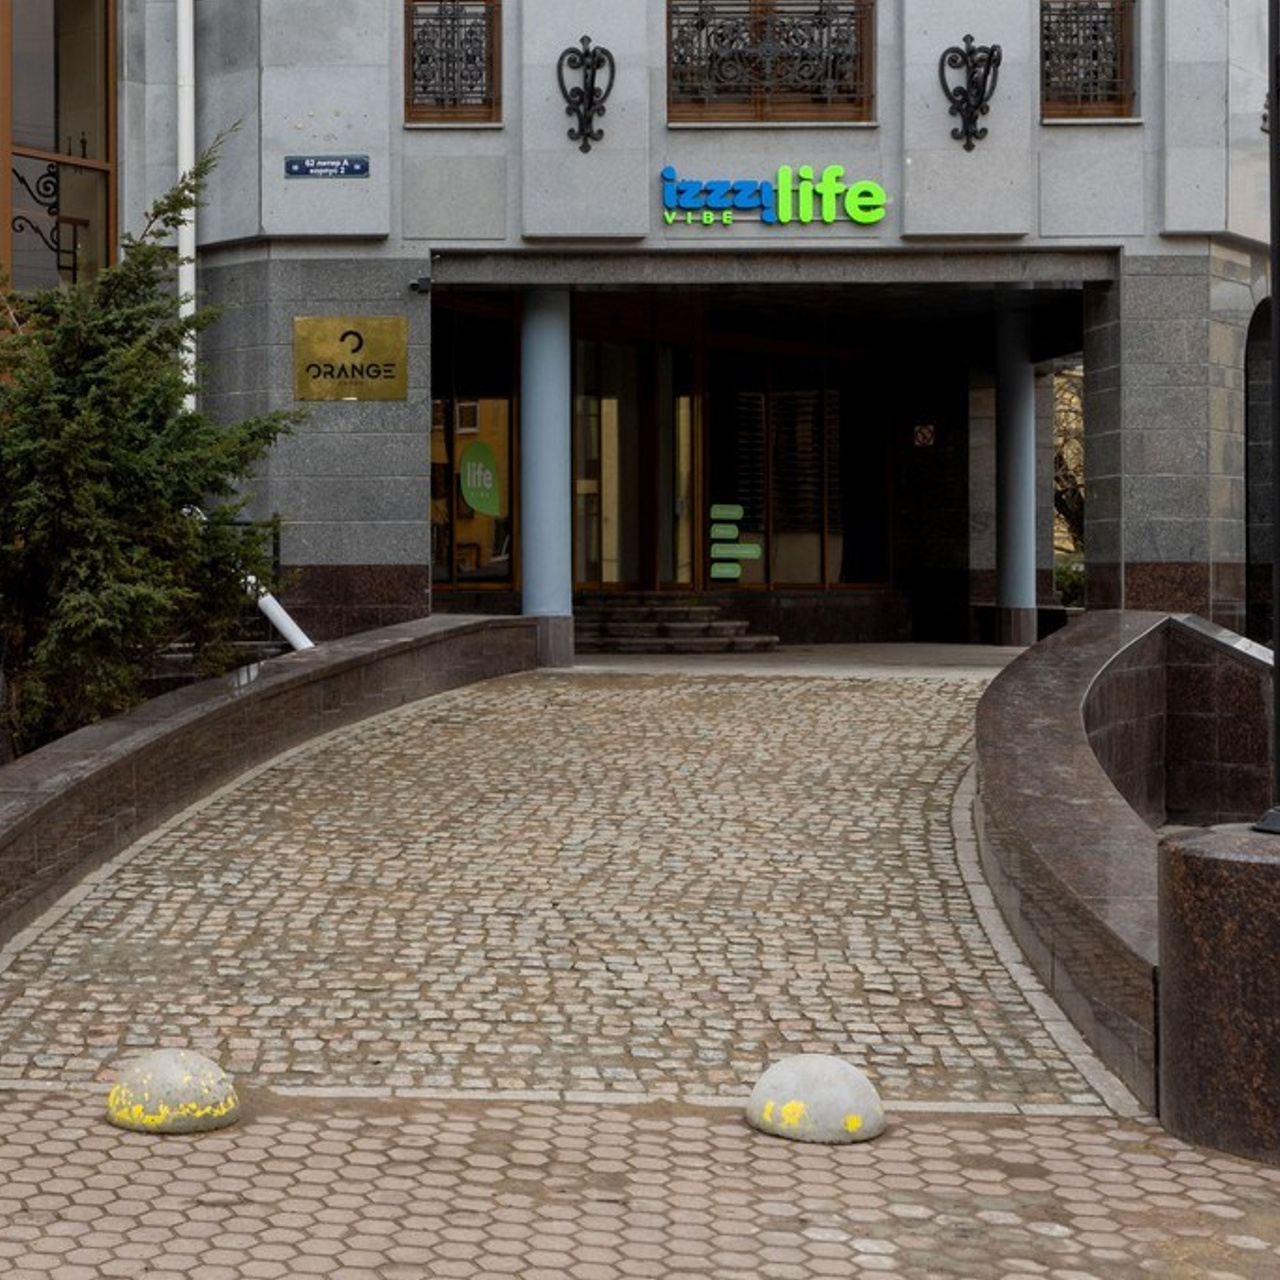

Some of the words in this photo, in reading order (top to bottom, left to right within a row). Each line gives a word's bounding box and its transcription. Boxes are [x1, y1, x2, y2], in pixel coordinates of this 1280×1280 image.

[777, 165, 887, 224] life
[663, 210, 733, 225] VIBE
[305, 363, 396, 380] ORANGE
